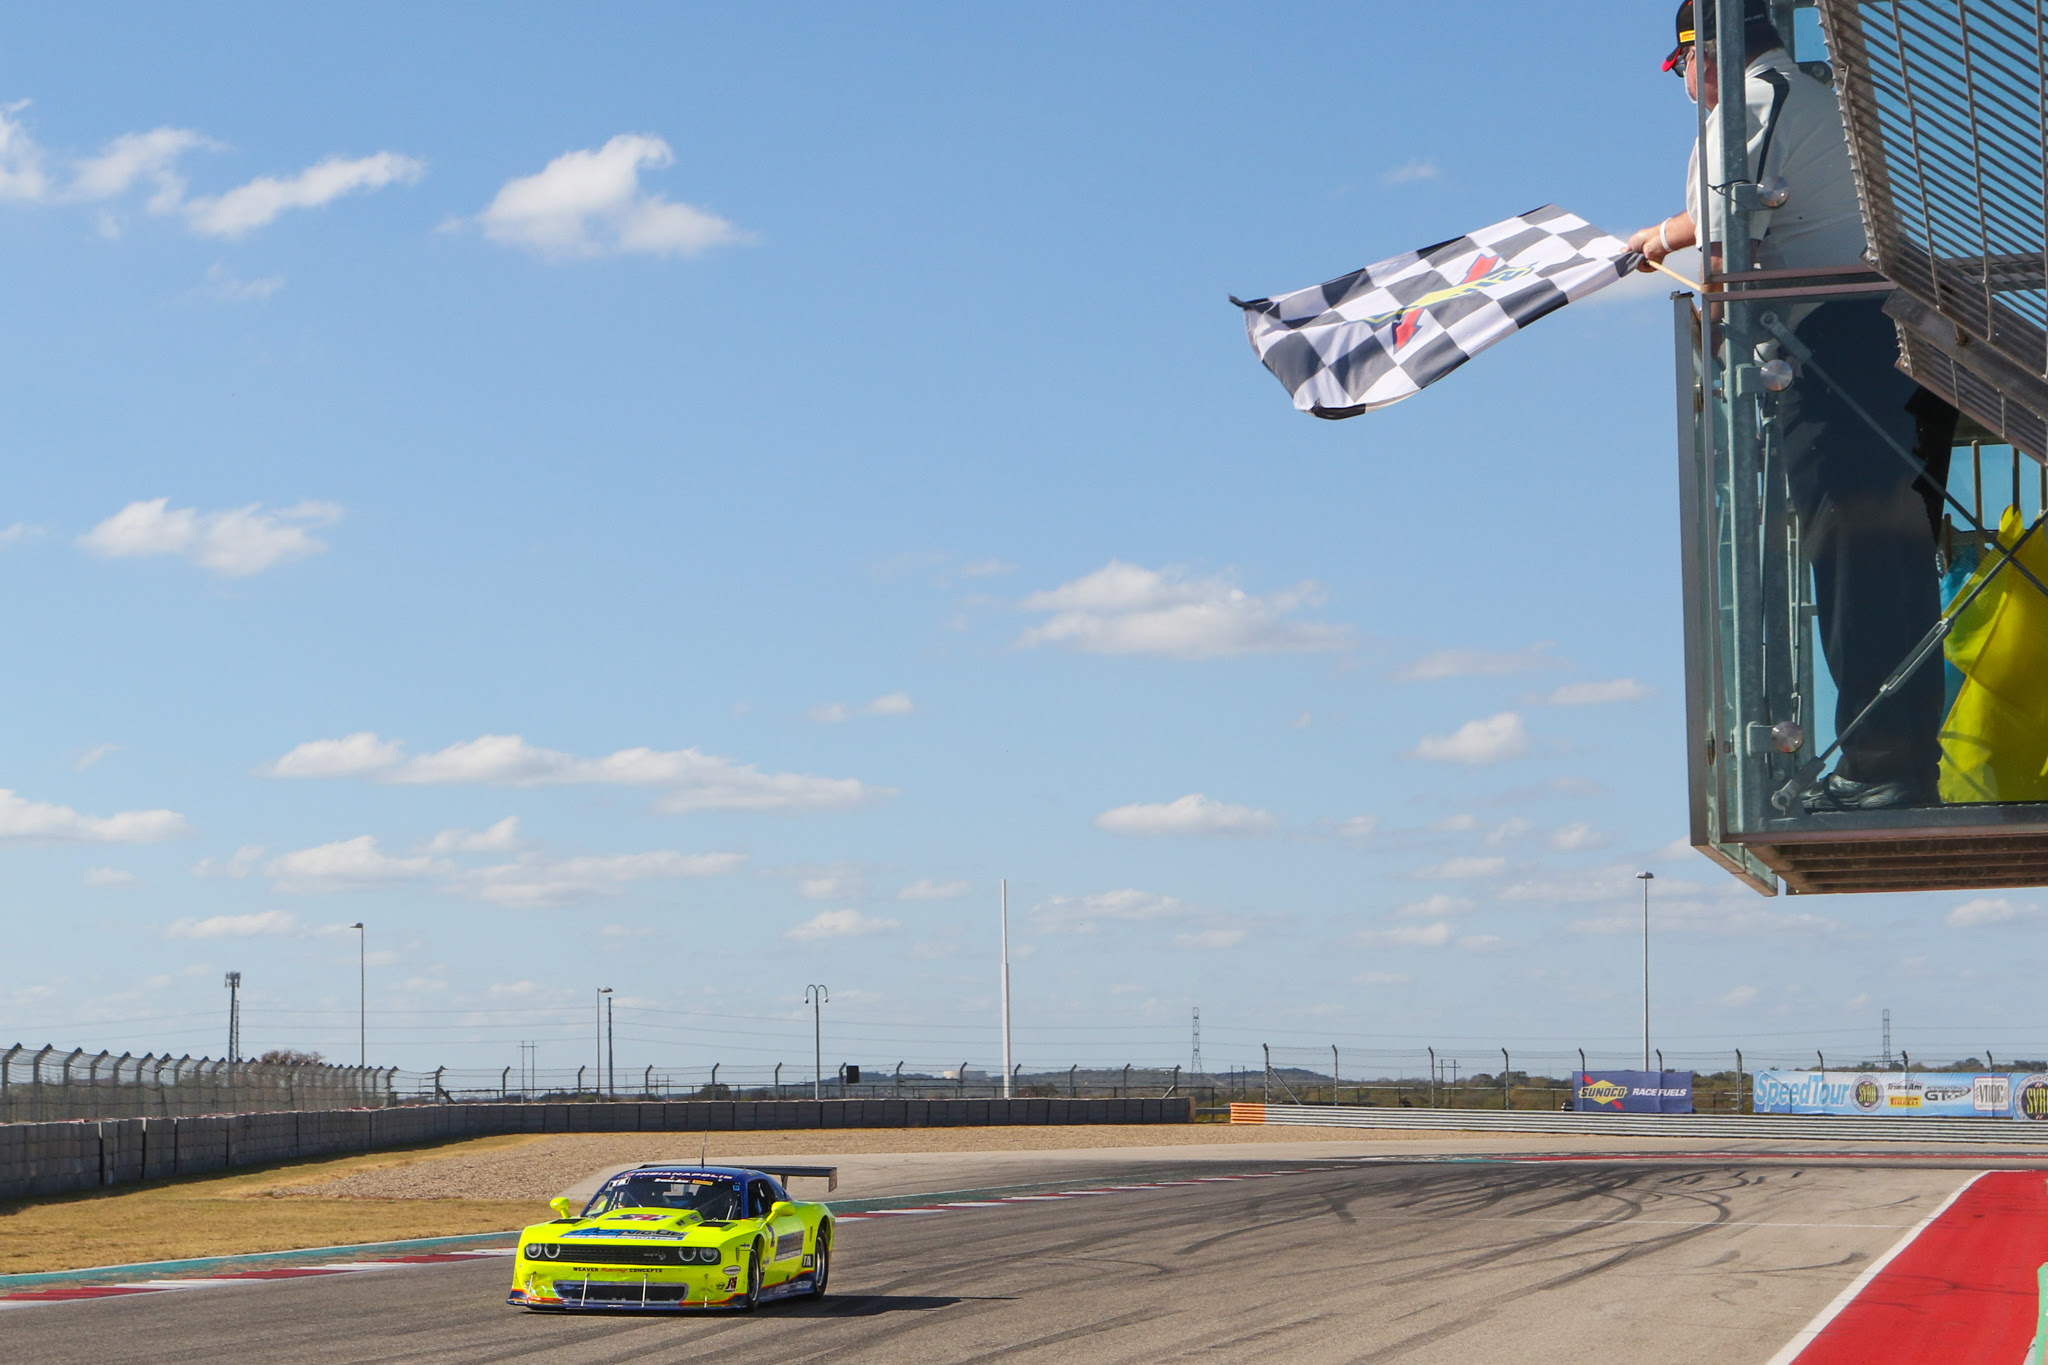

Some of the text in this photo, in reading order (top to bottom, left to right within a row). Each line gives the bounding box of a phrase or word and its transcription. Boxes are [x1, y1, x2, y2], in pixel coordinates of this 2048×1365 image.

[1581, 1087, 1625, 1098] SUNOCO
[1632, 1088, 1687, 1097] RACE FUELS
[1754, 1072, 1849, 1112] SpeedTour
[1978, 1085, 2004, 1103] VROC
[635, 1172, 733, 1180] INDIANAPOLIS
[803, 1256, 812, 1267] TA
